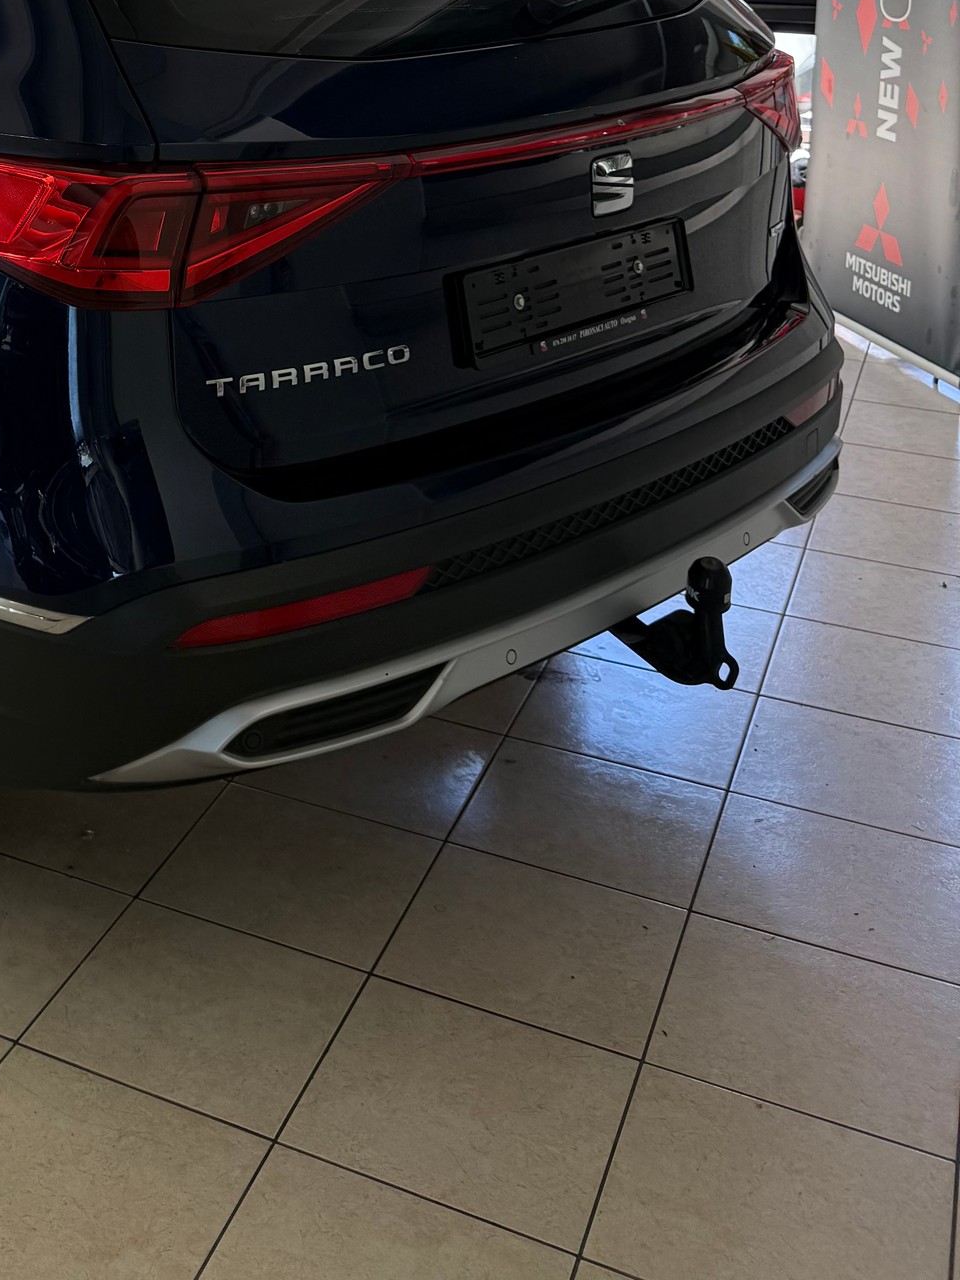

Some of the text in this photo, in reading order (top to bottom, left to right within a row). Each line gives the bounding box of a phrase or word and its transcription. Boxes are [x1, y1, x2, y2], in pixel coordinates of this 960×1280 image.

[876, 36, 903, 143] NEW
[845, 251, 912, 298] MITSUBISHI
[852, 274, 901, 313] MOTORS
[205, 344, 411, 398] TARRACO
